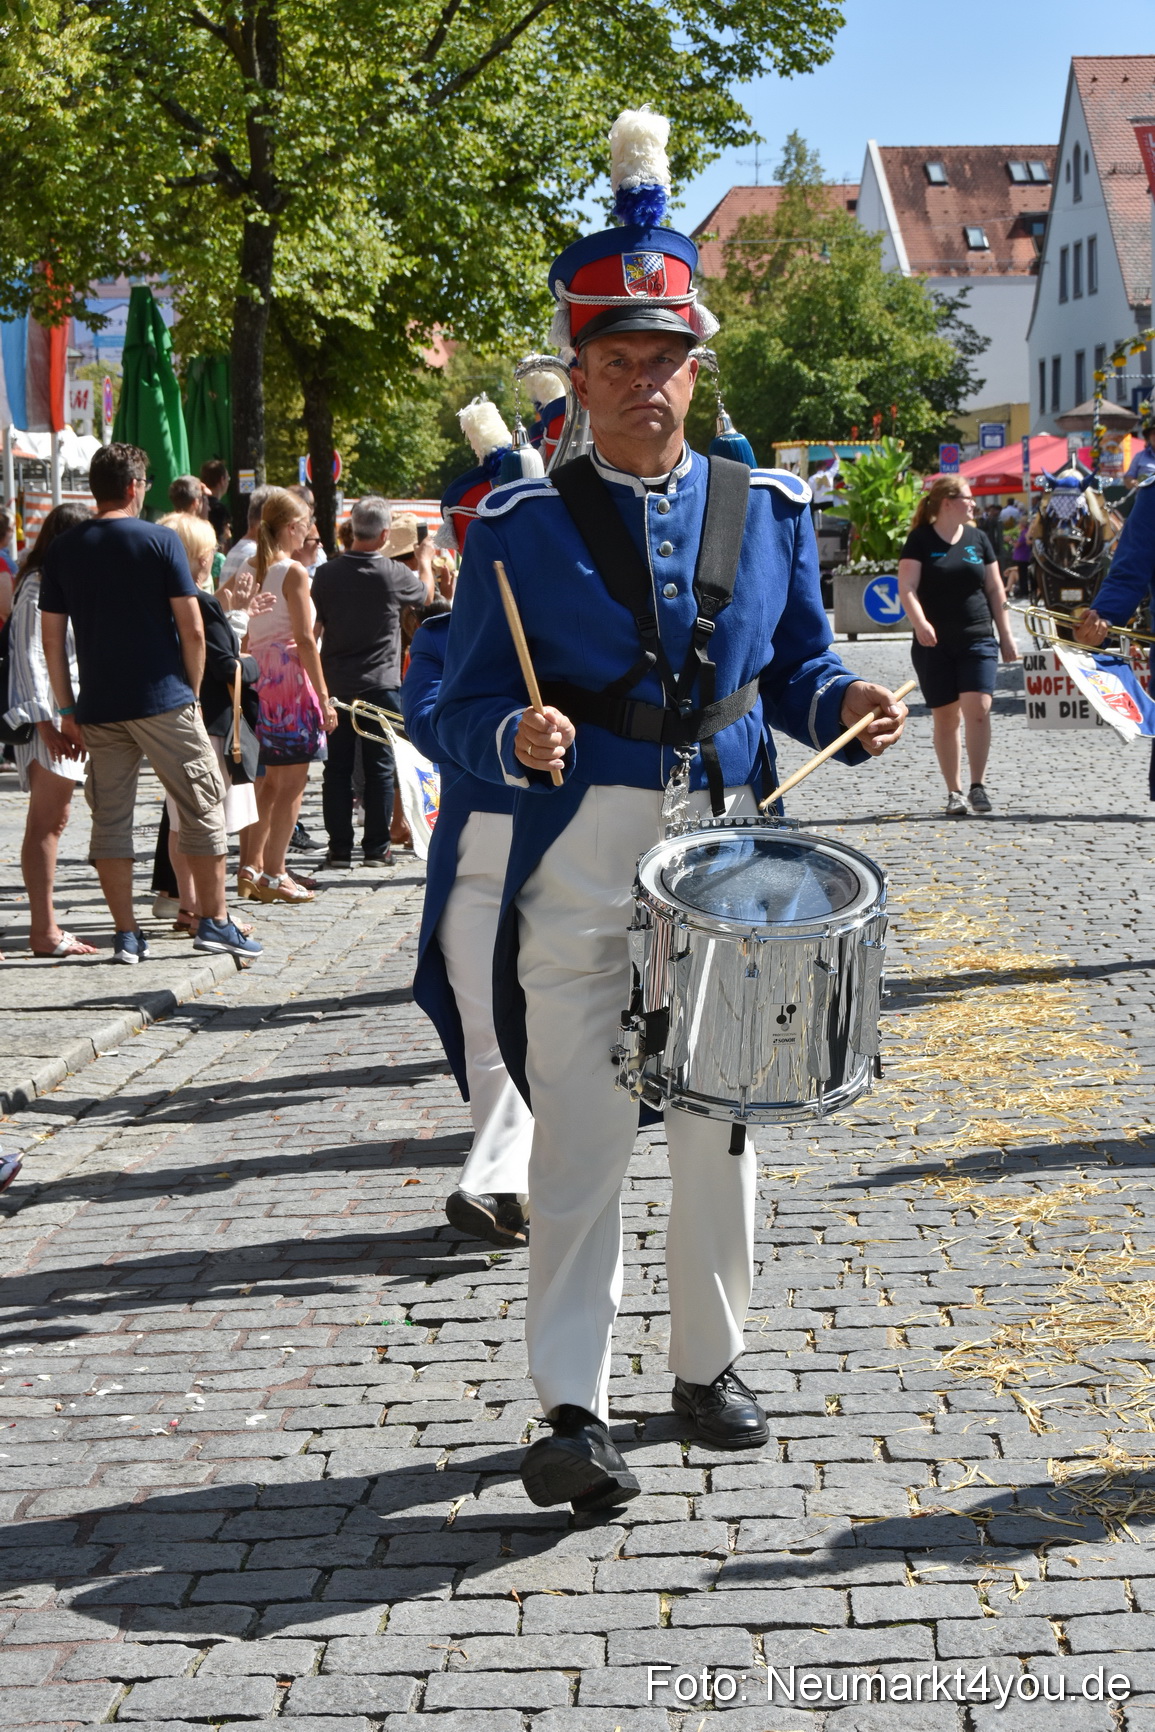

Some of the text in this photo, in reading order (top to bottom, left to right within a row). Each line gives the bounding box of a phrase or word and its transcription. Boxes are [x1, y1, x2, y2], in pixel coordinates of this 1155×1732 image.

[942, 464, 958, 473] TAXI
[1023, 655, 1047, 671] WIR
[1028, 701, 1090, 719] IN DIE
